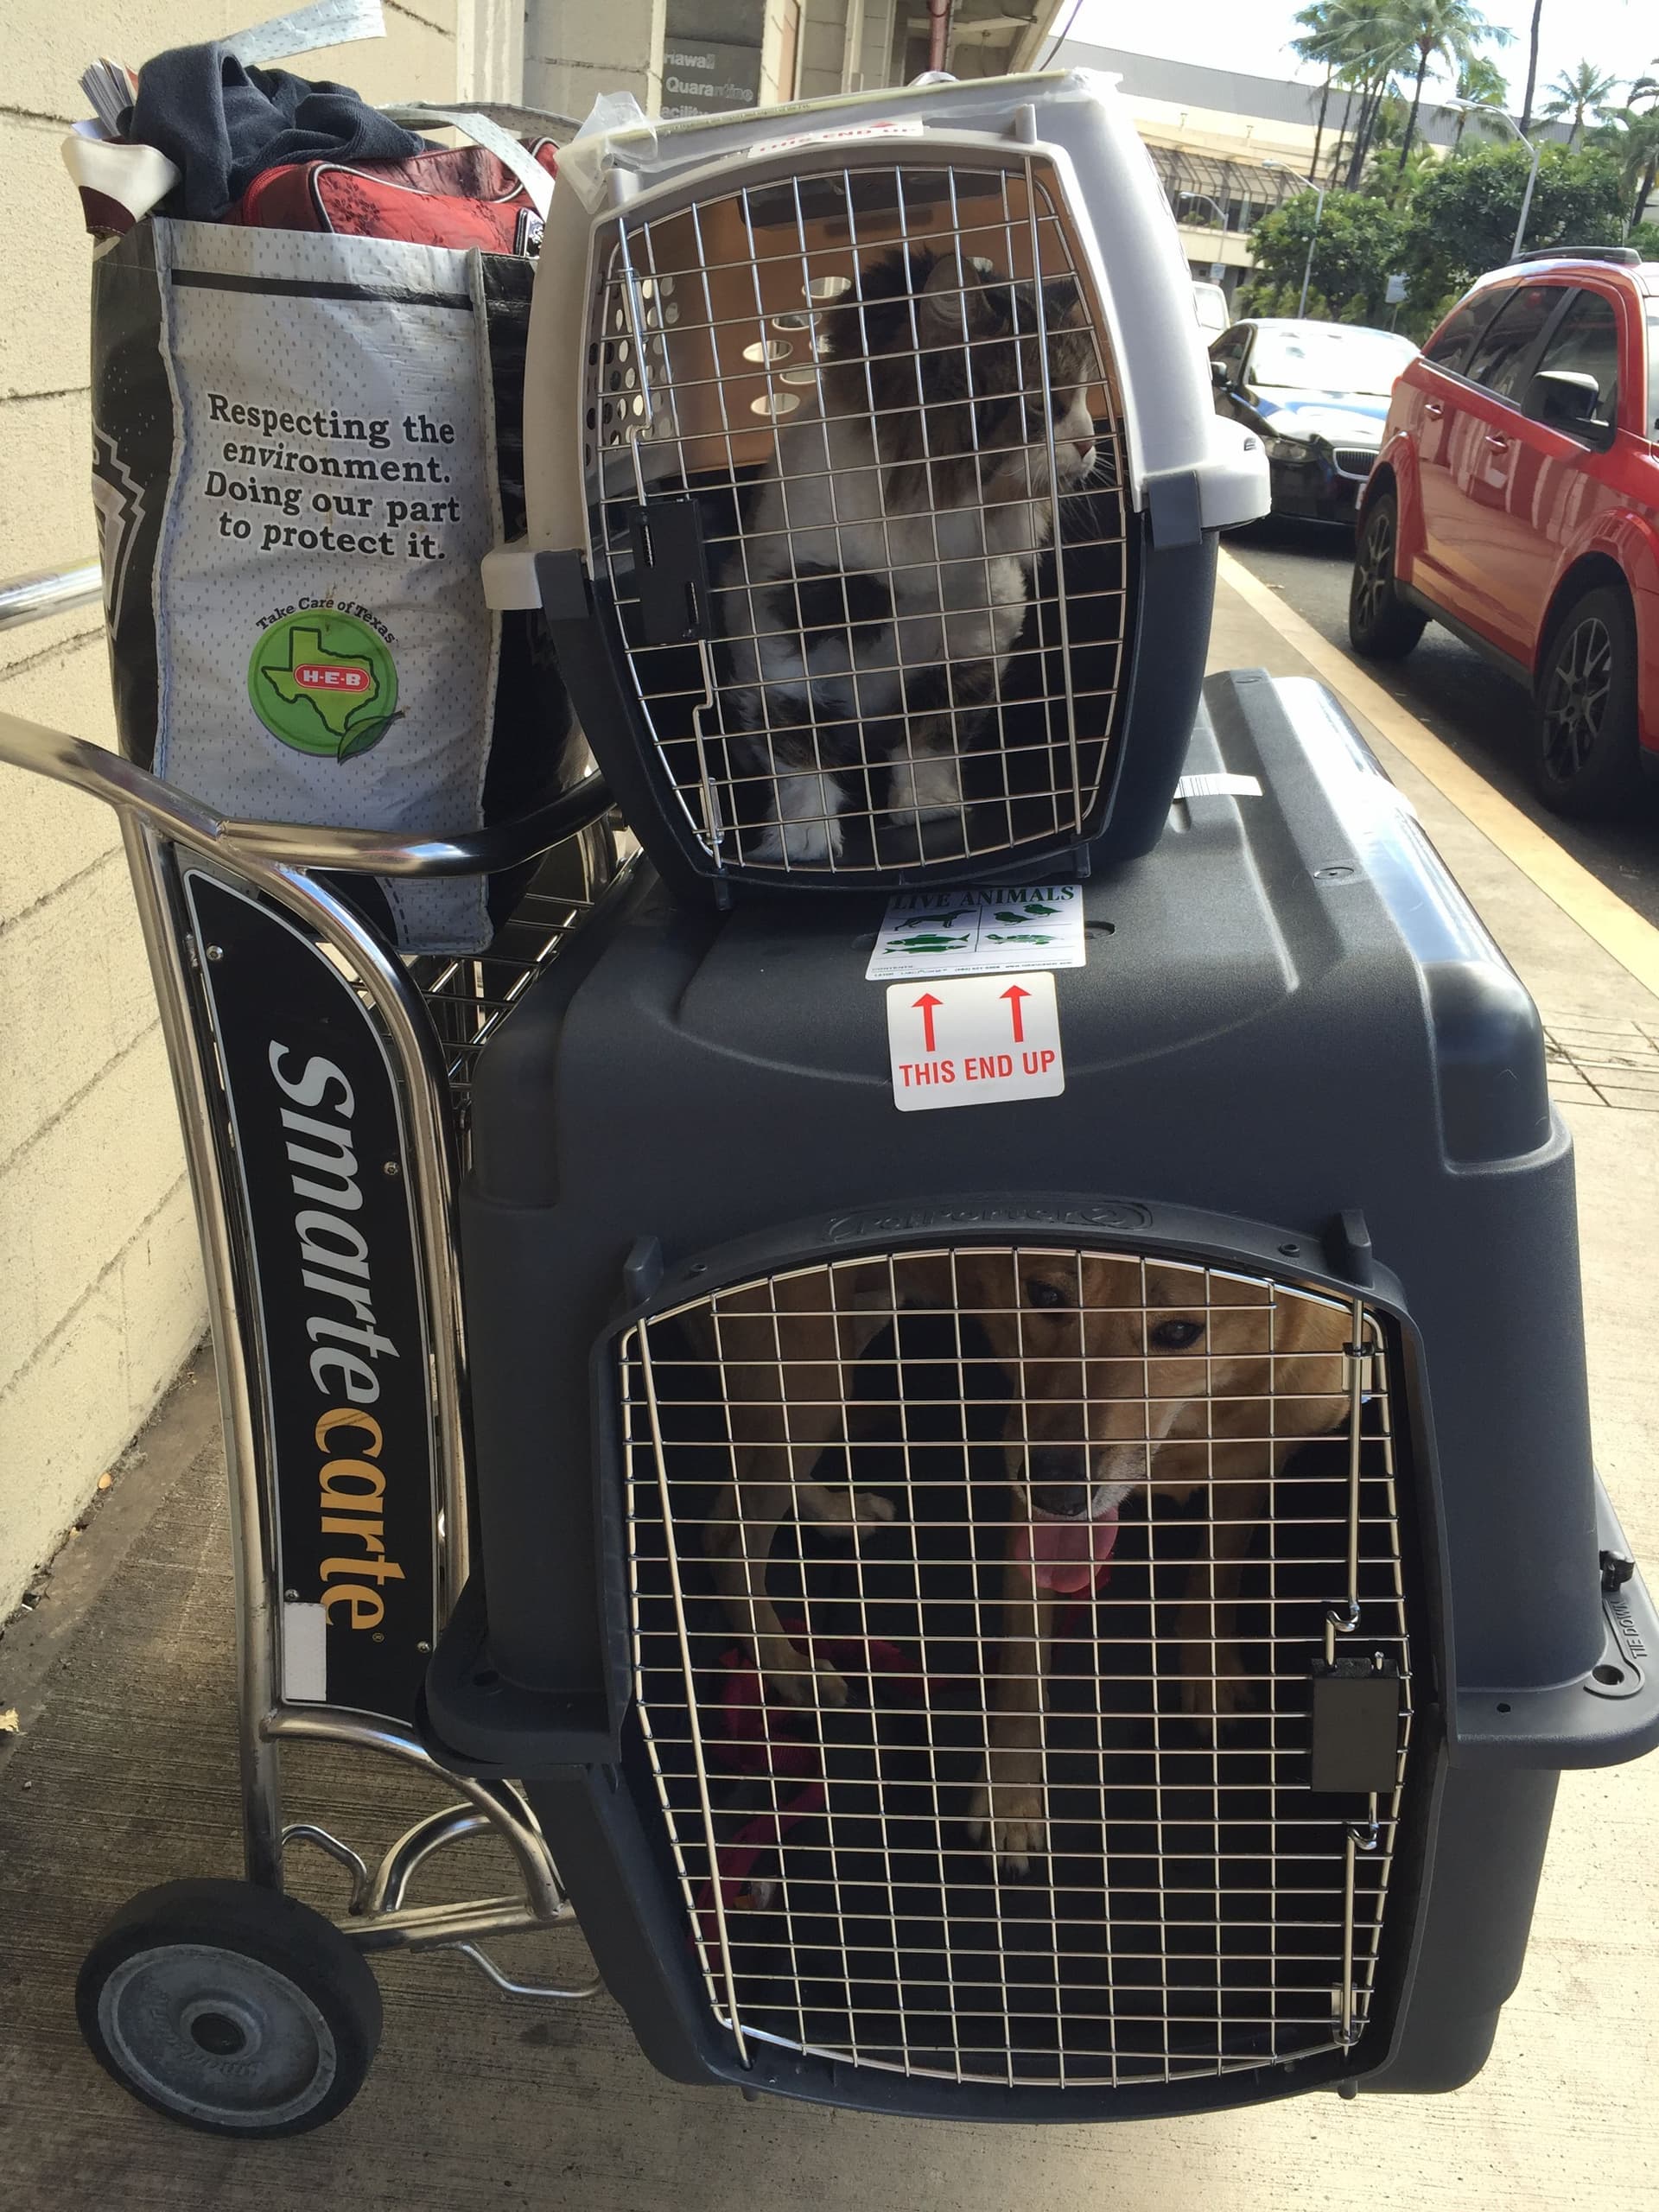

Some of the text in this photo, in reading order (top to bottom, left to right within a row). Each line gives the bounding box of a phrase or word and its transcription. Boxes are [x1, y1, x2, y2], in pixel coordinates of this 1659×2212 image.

[665, 76, 754, 102] Quarantine
[207, 393, 455, 448] Respecting the
[223, 442, 450, 483] environment.
[205, 470, 461, 527] Doing our part
[219, 512, 446, 559] to protect it.
[256, 605, 296, 631] Take
[298, 597, 334, 610] Care
[337, 601, 355, 611] of
[893, 886, 1075, 909] LIVE ANIMALS
[899, 1050, 1055, 1087] THIS END UP
[1611, 1600, 1648, 1659] TIE DOWN
